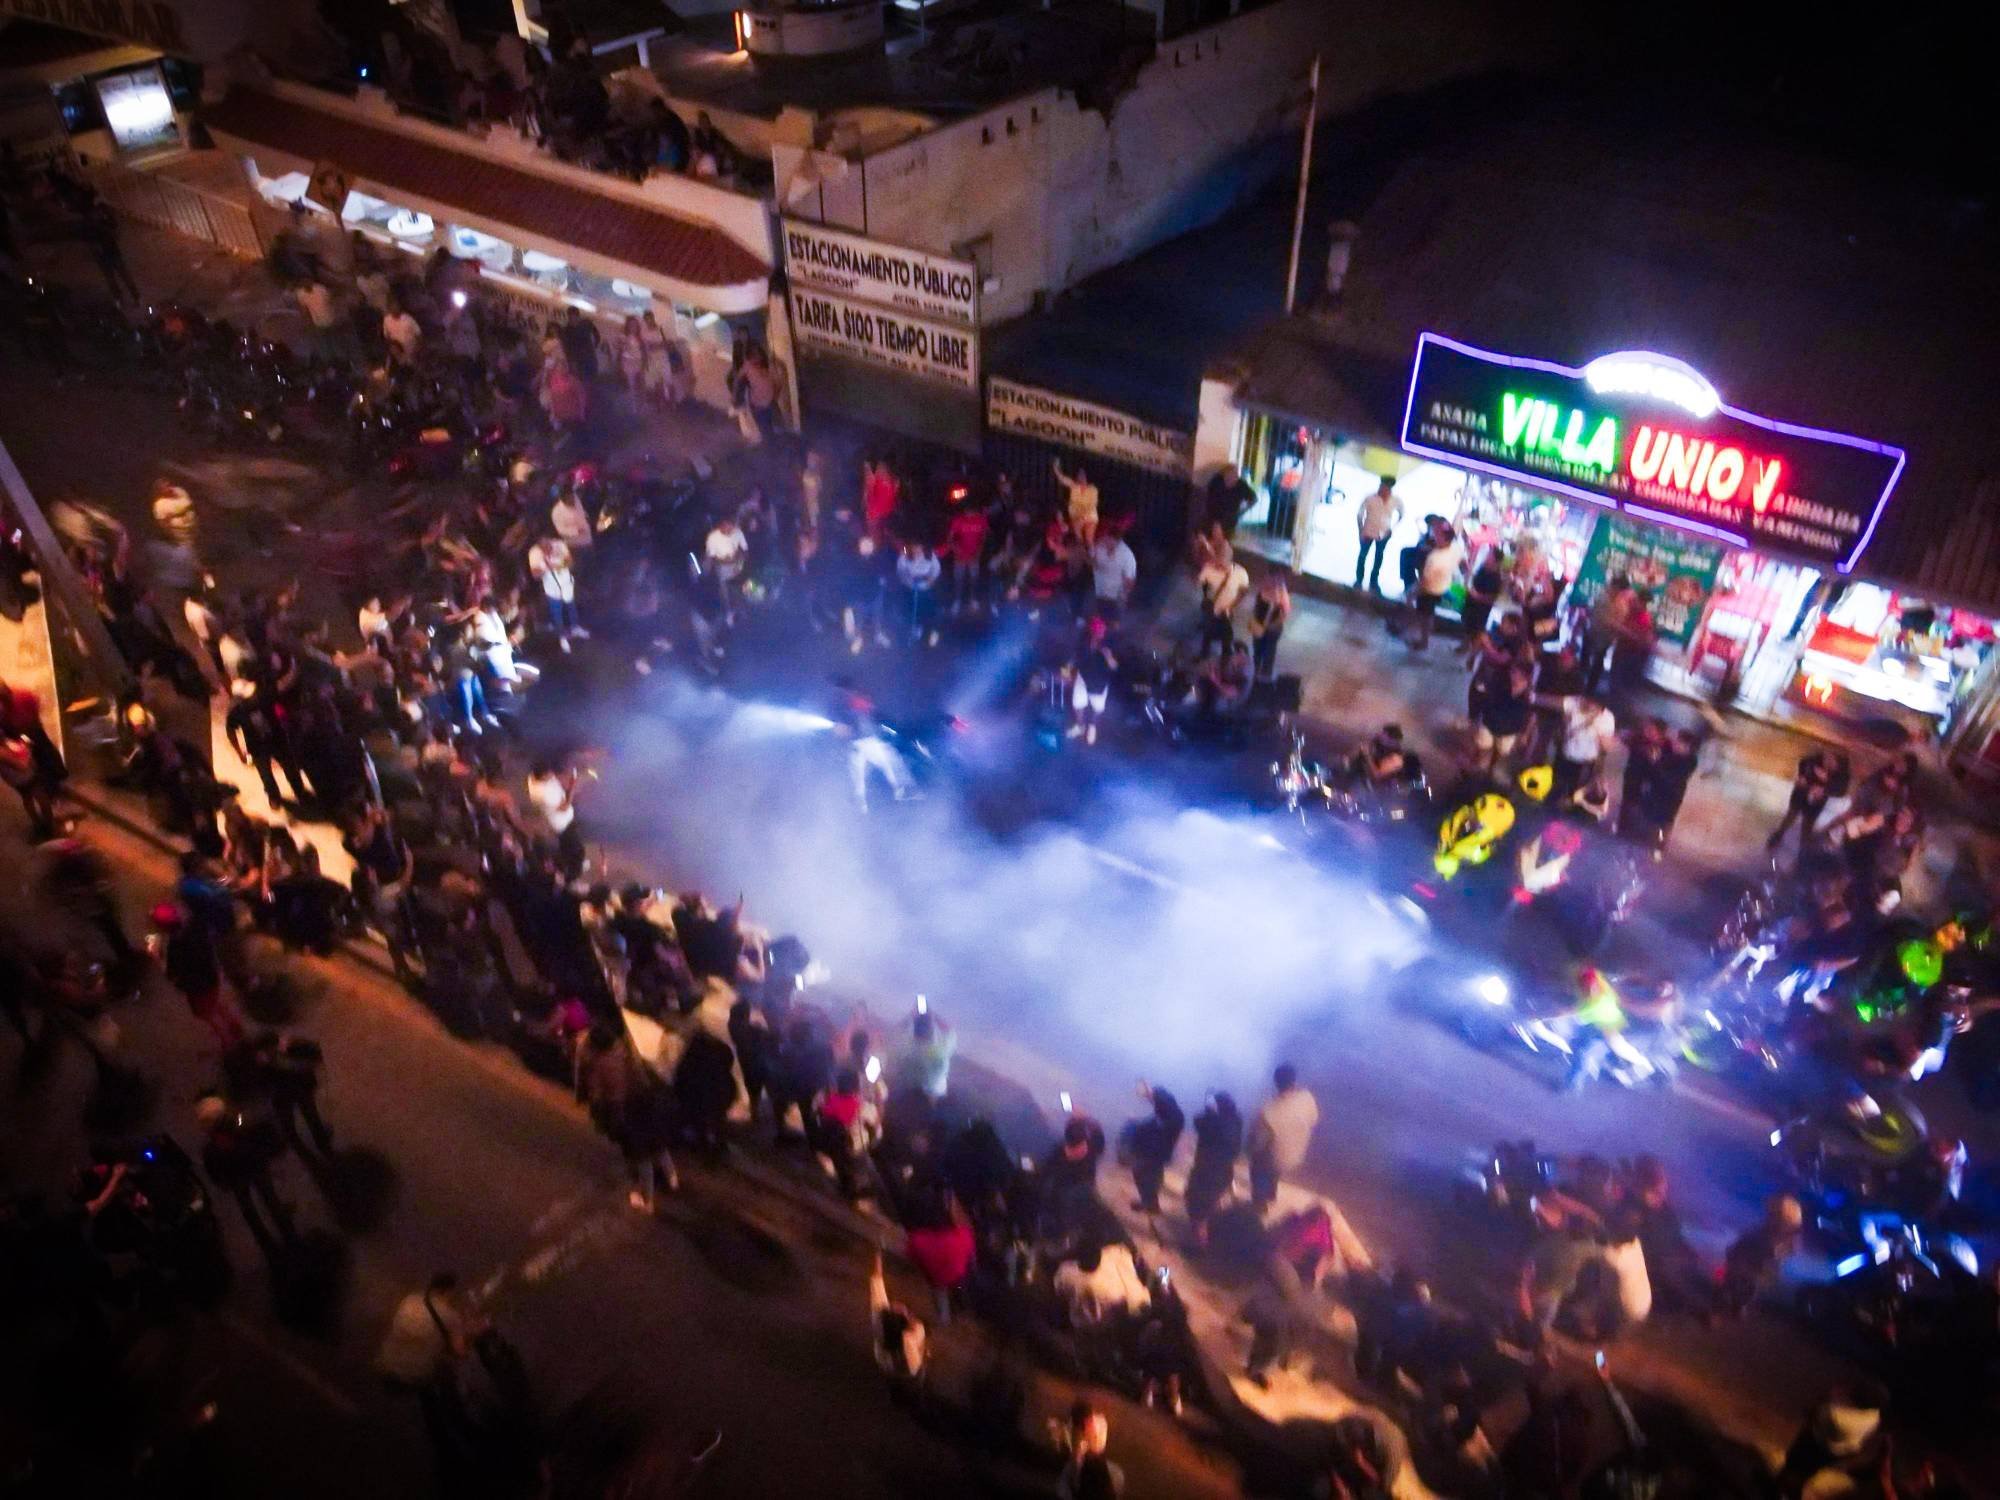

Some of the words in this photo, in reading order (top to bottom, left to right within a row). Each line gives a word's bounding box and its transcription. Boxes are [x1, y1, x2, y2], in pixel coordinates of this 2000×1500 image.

[788, 232, 910, 287] ESTACIONAMIENTO
[795, 294, 840, 334] TARIFA
[843, 306, 874, 344] $100
[875, 315, 928, 359] TIEMPO
[931, 331, 969, 371] LIBRE
[992, 384, 1125, 434] ESTACIONAMIENTO
[1502, 392, 1617, 474] VILLA
